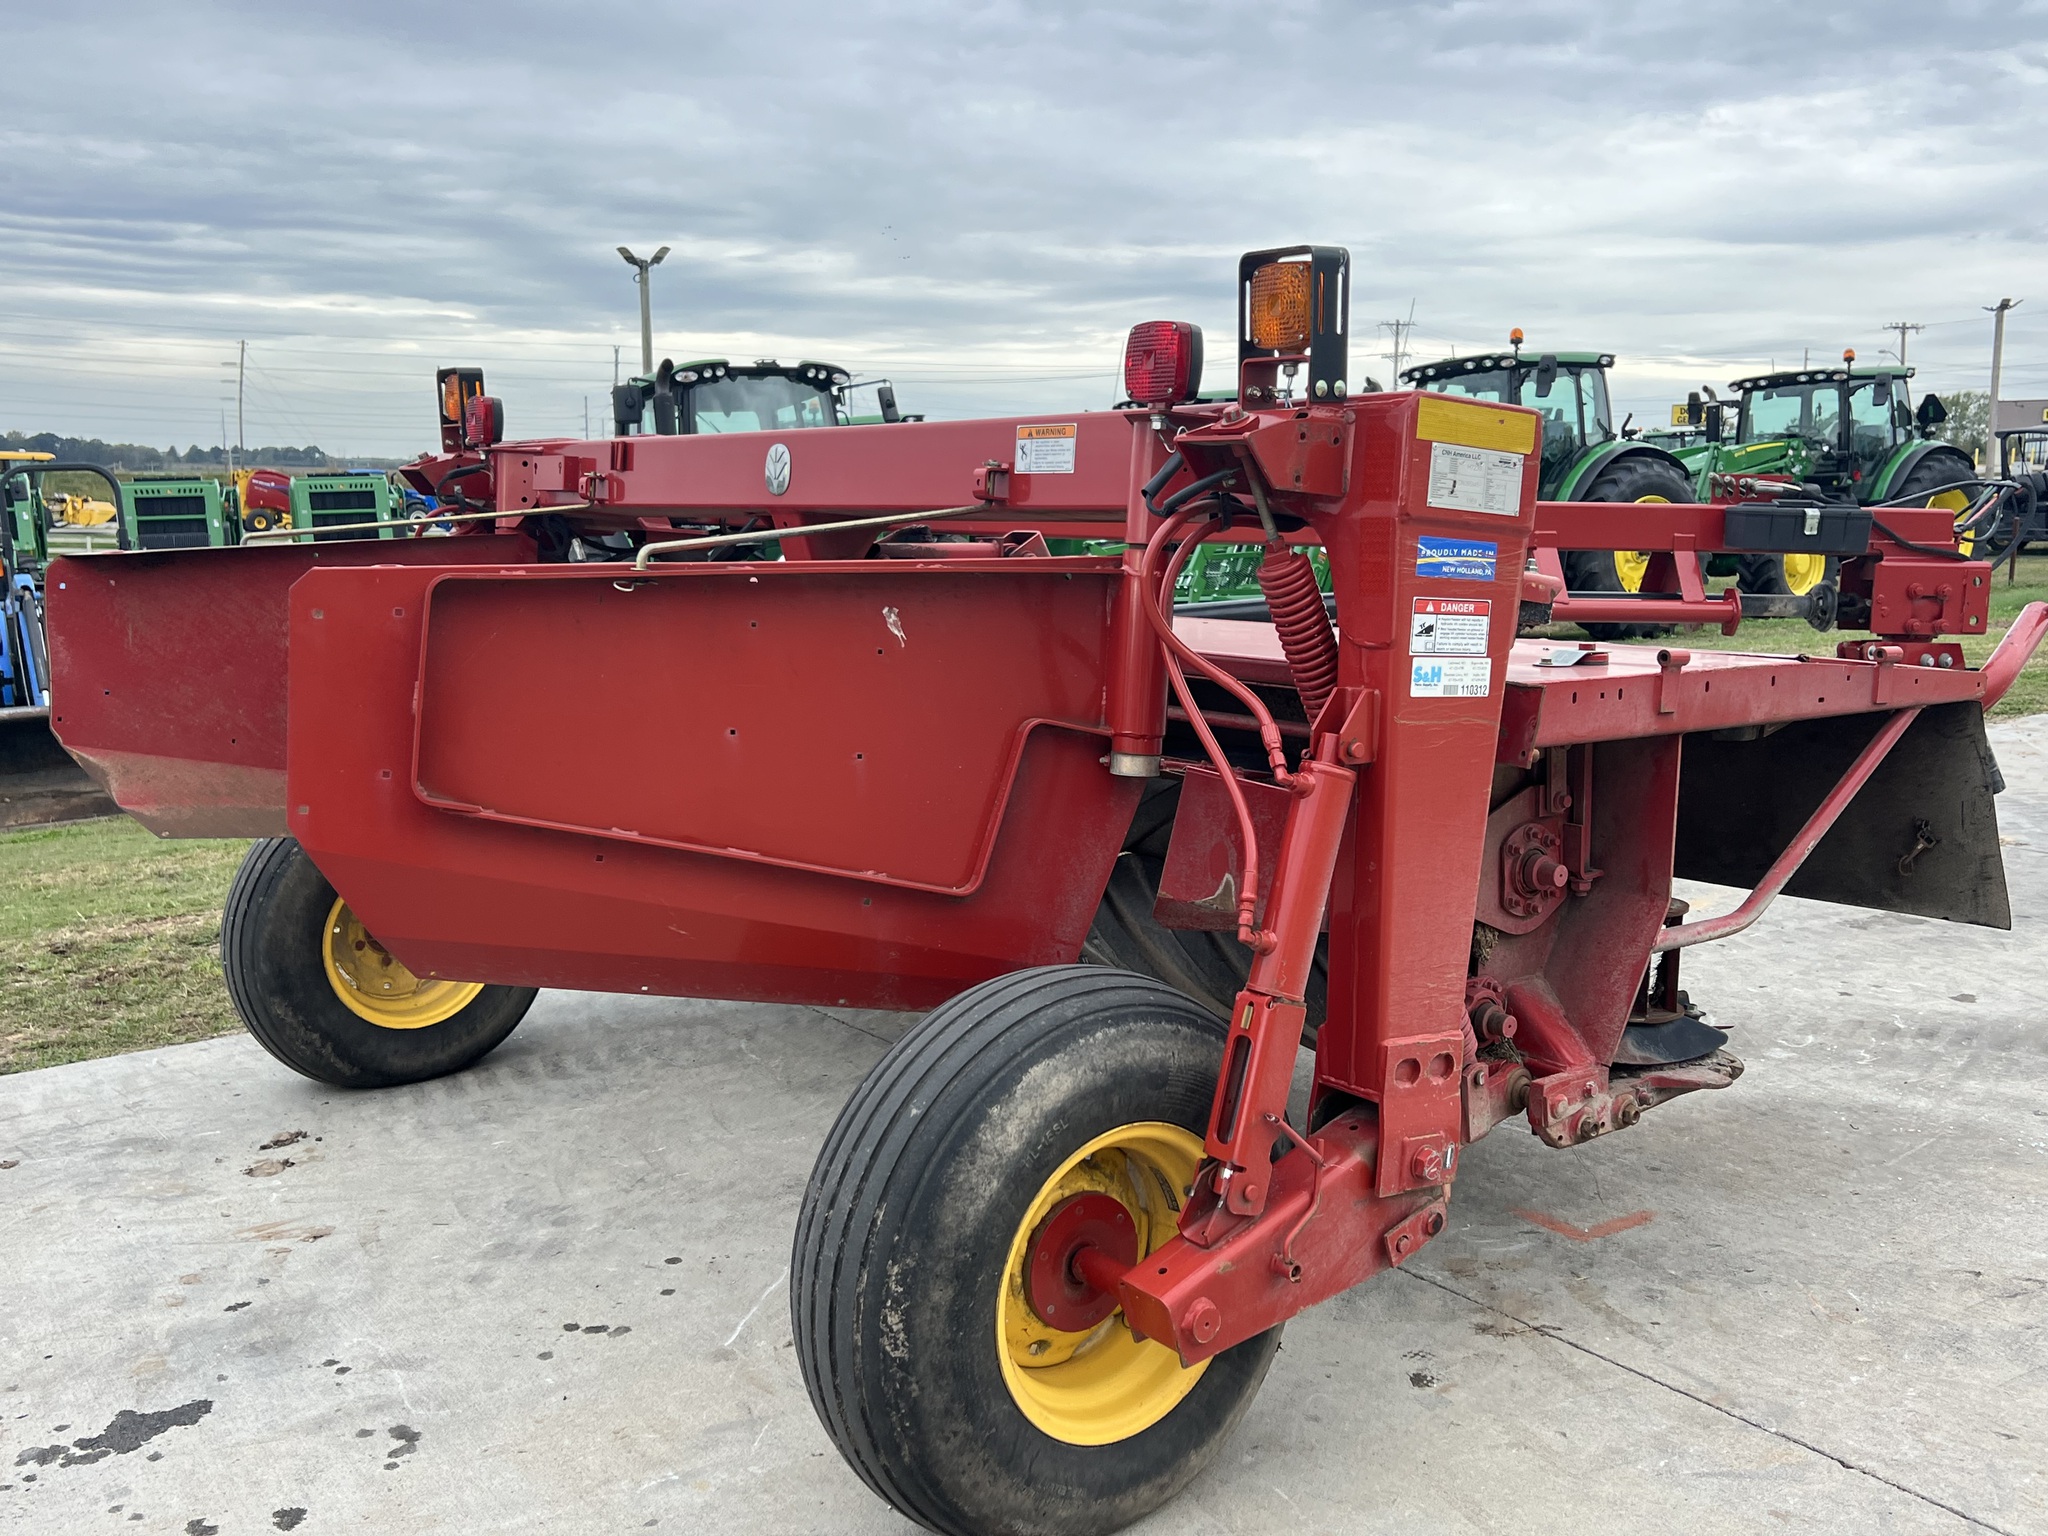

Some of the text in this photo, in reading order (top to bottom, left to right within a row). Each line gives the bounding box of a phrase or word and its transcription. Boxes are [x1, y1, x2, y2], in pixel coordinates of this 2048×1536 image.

[1035, 427, 1066, 436] WARNING
[1453, 450, 1471, 459] America
[1420, 548, 1458, 557] PROUDLY
[1461, 548, 1483, 557] MADE
[1442, 565, 1455, 573] NEW
[1440, 602, 1475, 613] DANGER
[1413, 666, 1442, 683] S&H
[1461, 684, 1488, 695] 110312
